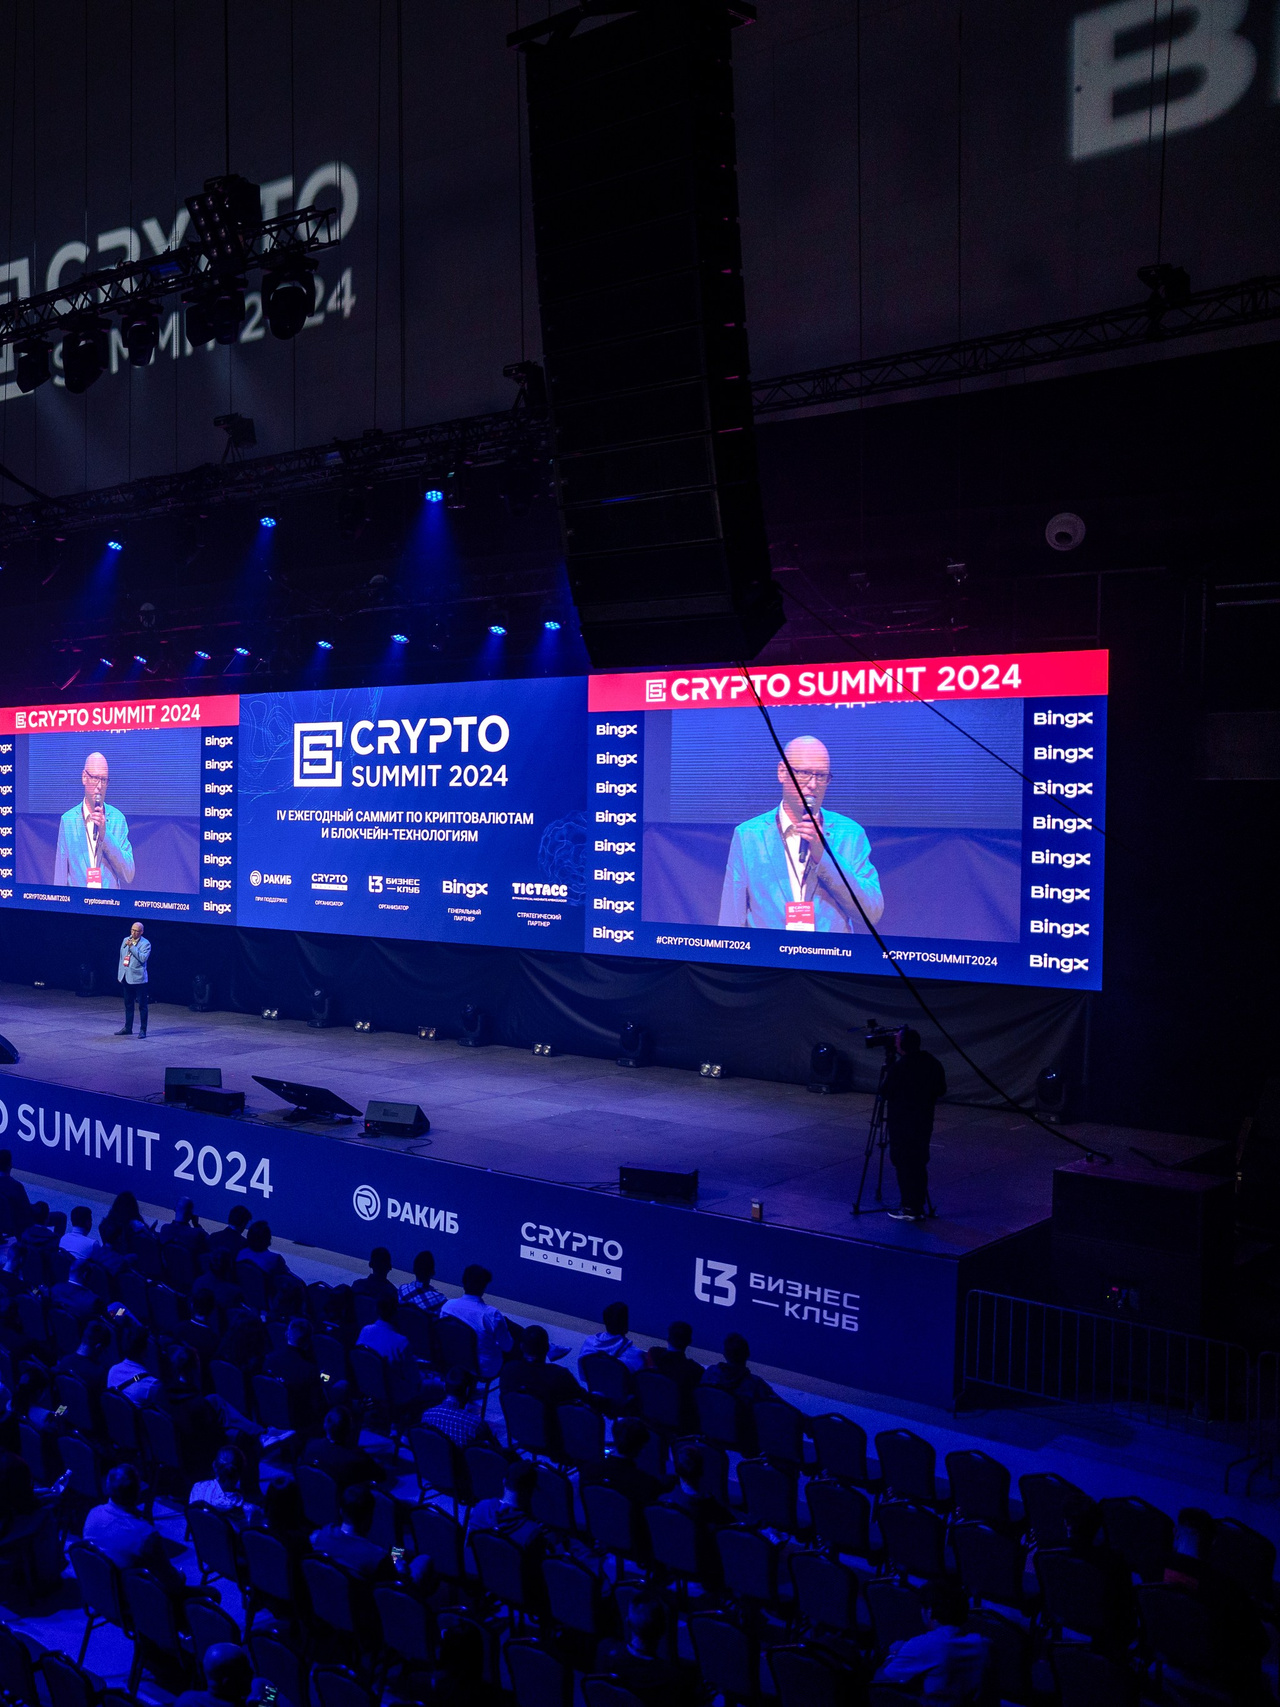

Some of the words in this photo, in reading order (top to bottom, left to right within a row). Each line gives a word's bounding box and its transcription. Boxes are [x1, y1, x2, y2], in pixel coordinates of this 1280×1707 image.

[671, 674, 790, 701] CRYPTO
[798, 667, 926, 696] SUMMIT
[937, 664, 1021, 691] 2024
[29, 709, 89, 727] CRYPTO
[93, 705, 156, 725] SUMMIT
[161, 704, 200, 722] 2024
[351, 715, 509, 755] CRYPTO
[352, 765, 441, 787] SUMMIT
[449, 765, 508, 786] 2024
[289, 809, 353, 824] ЕЖЕГОДНЫЙ
[356, 811, 402, 823] САММИТ
[406, 811, 422, 823] ПО
[425, 812, 533, 825] КРИПТОВАЛЮТАМ
[321, 827, 328, 839] И
[331, 826, 478, 842] БЛОКЧЕЙН-ТЕХНОЛОГИЯМ
[263, 873, 291, 885] РАКИБ
[312, 873, 347, 885] CRYPTO
[386, 877, 420, 886] БИЗНЕС
[84, 898, 120, 906] cryptosummit.ru
[134, 900, 189, 911] #CRYPTOSUMMIT2024
[657, 936, 750, 951] #CRYPTOSUMMIT2024
[779, 945, 851, 957] cryptosummit.ru
[883, 951, 997, 967] #CRYPTOSUMMIT2024
[18, 1104, 159, 1170] SUMMIT
[174, 1140, 273, 1198] 2024
[388, 1198, 458, 1234] РАКИБ
[521, 1222, 623, 1260] CRYPTO
[529, 1251, 612, 1275] HOLDING
[749, 1272, 860, 1310] БИЗНЕС
